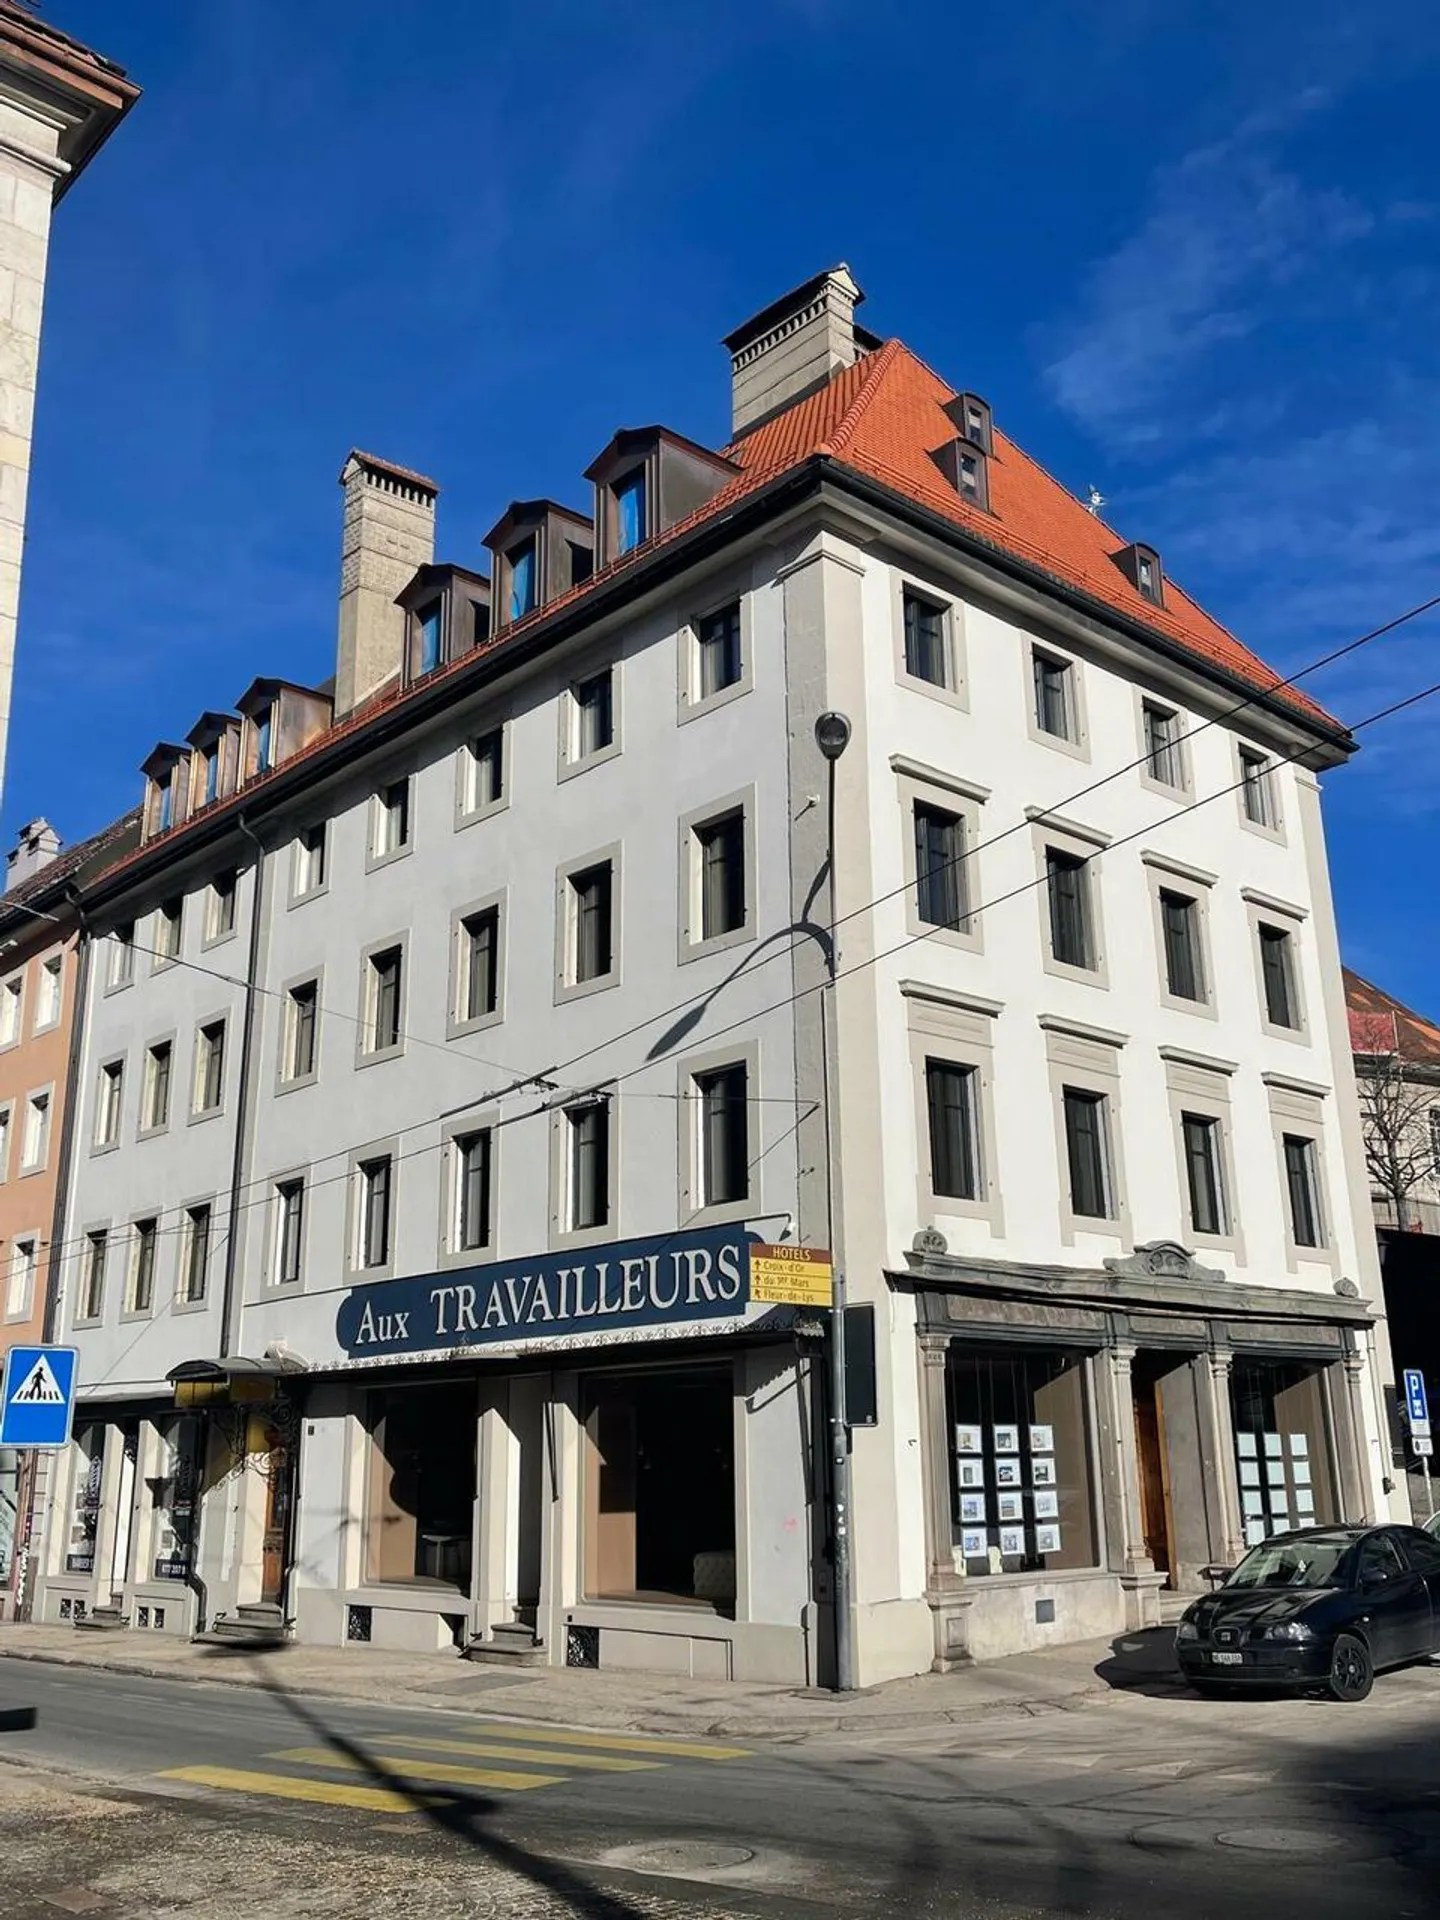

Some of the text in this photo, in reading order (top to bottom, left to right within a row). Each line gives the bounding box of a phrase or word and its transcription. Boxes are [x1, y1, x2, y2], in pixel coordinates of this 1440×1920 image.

[772, 1247, 812, 1261] HOTELS
[355, 1245, 741, 1345] Aux TRAVAILLEURS
[1410, 1375, 1419, 1398] P
